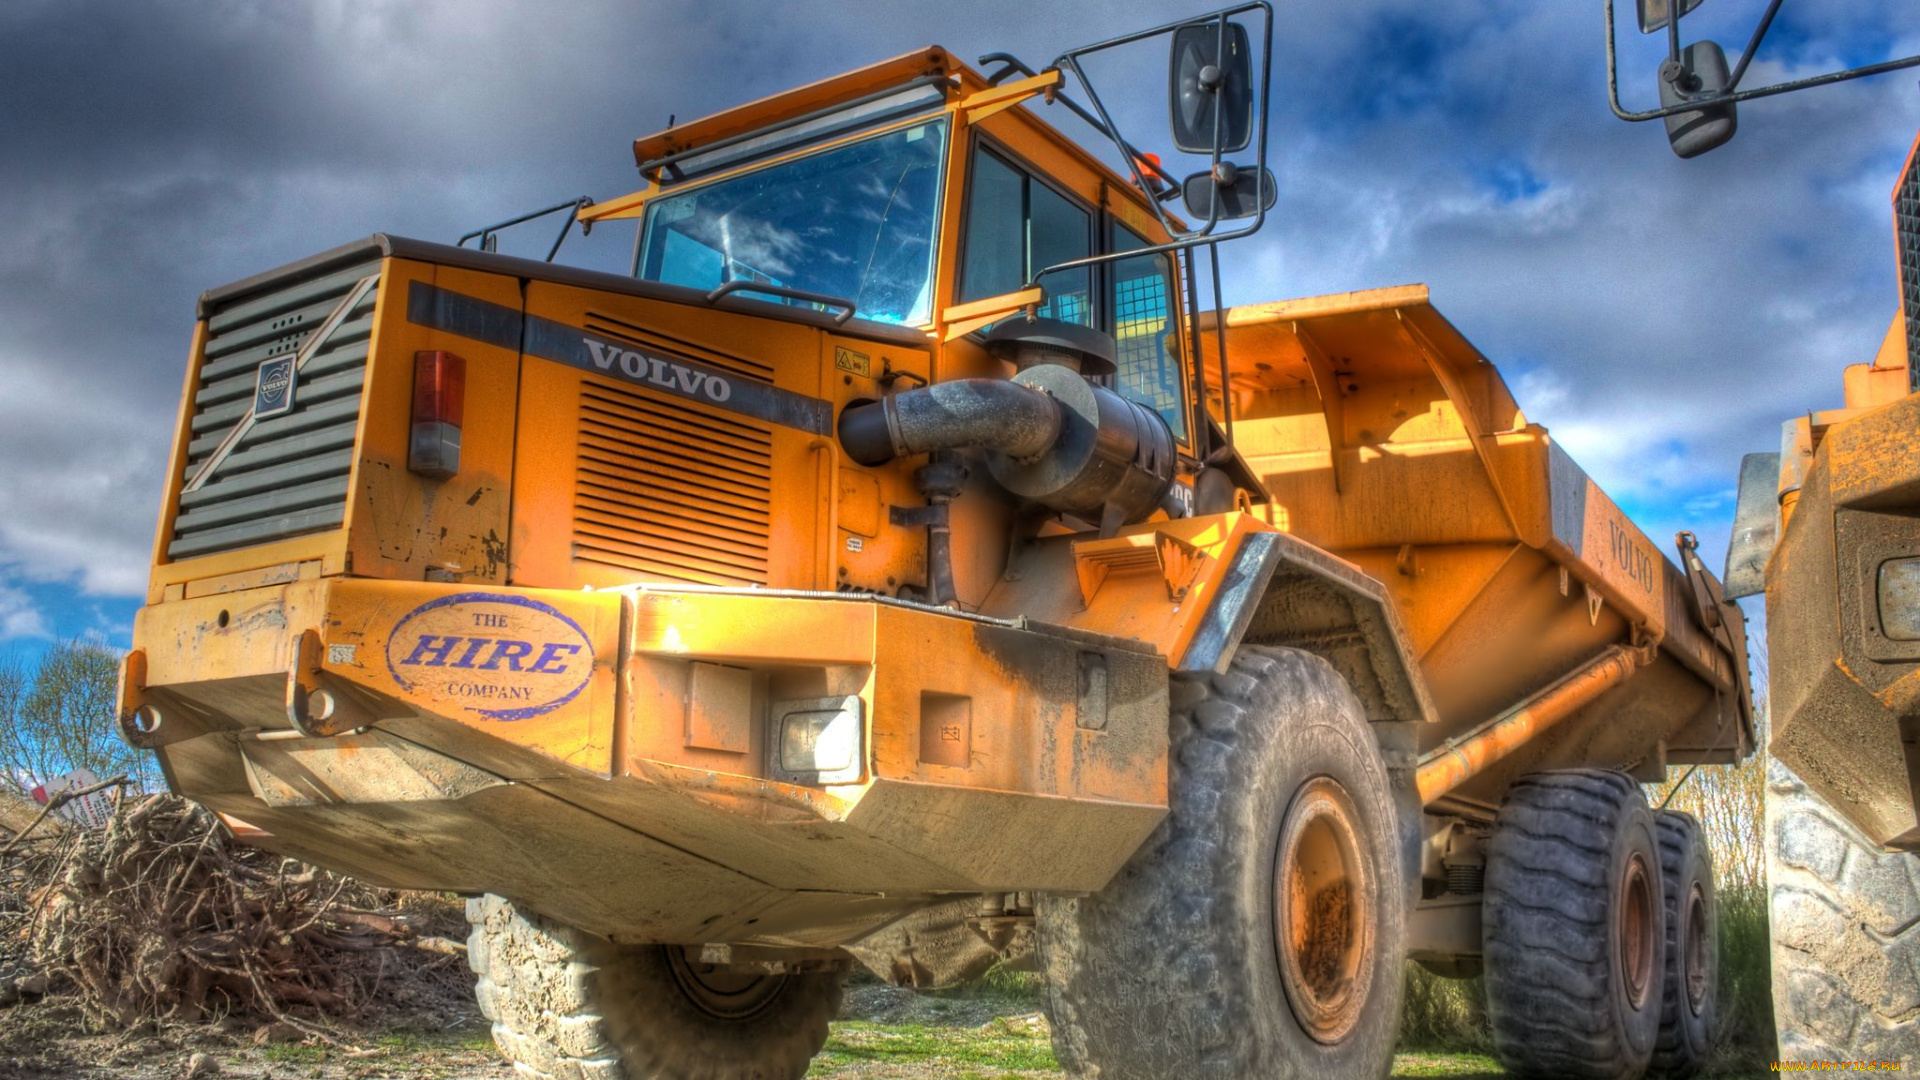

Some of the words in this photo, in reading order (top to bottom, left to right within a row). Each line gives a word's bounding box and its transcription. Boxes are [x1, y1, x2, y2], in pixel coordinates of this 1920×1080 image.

[583, 338, 731, 402] VOLVO
[262, 380, 287, 391] VOLVO
[1609, 520, 1653, 594] VOLVO
[472, 613, 508, 628] THE
[400, 634, 582, 674] HIRE
[447, 683, 534, 700] COMPANY
